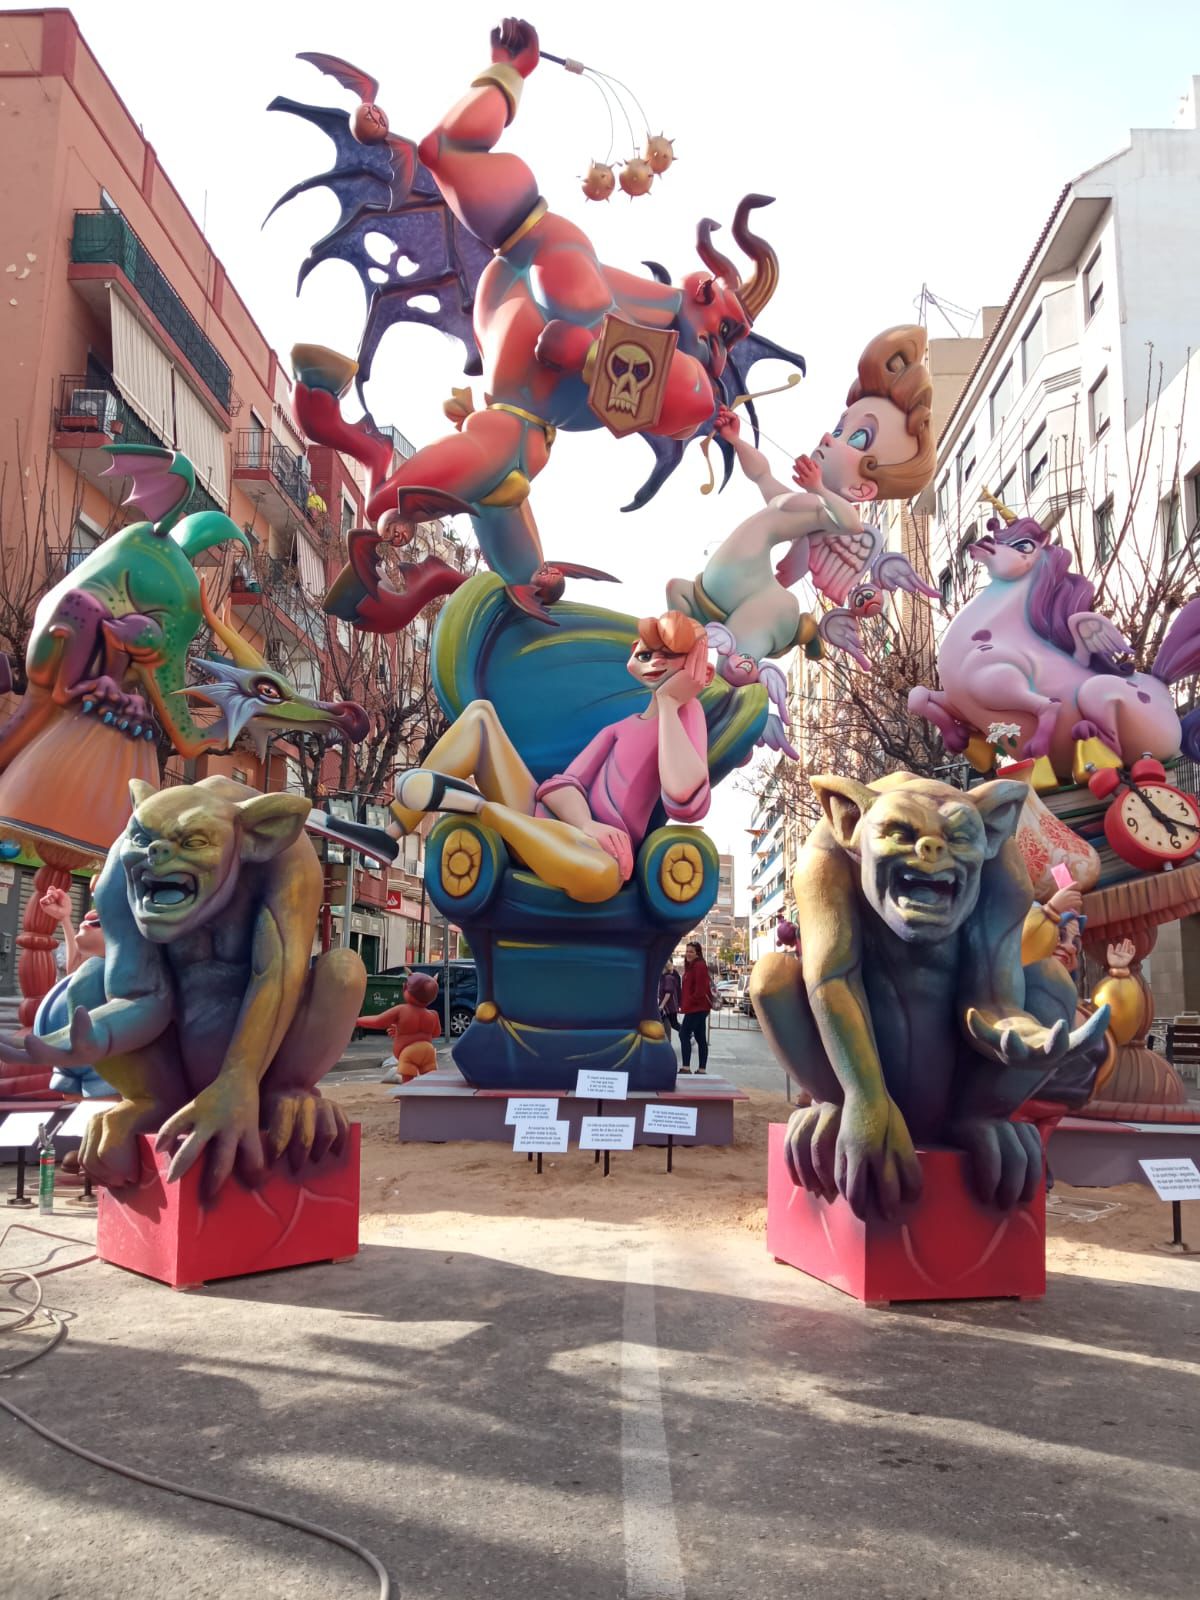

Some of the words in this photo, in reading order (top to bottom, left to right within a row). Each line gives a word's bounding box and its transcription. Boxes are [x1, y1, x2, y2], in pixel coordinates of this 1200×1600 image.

[1176, 801, 1189, 817] 3
[1127, 817, 1139, 834] 9
[1170, 832, 1182, 849] 6
